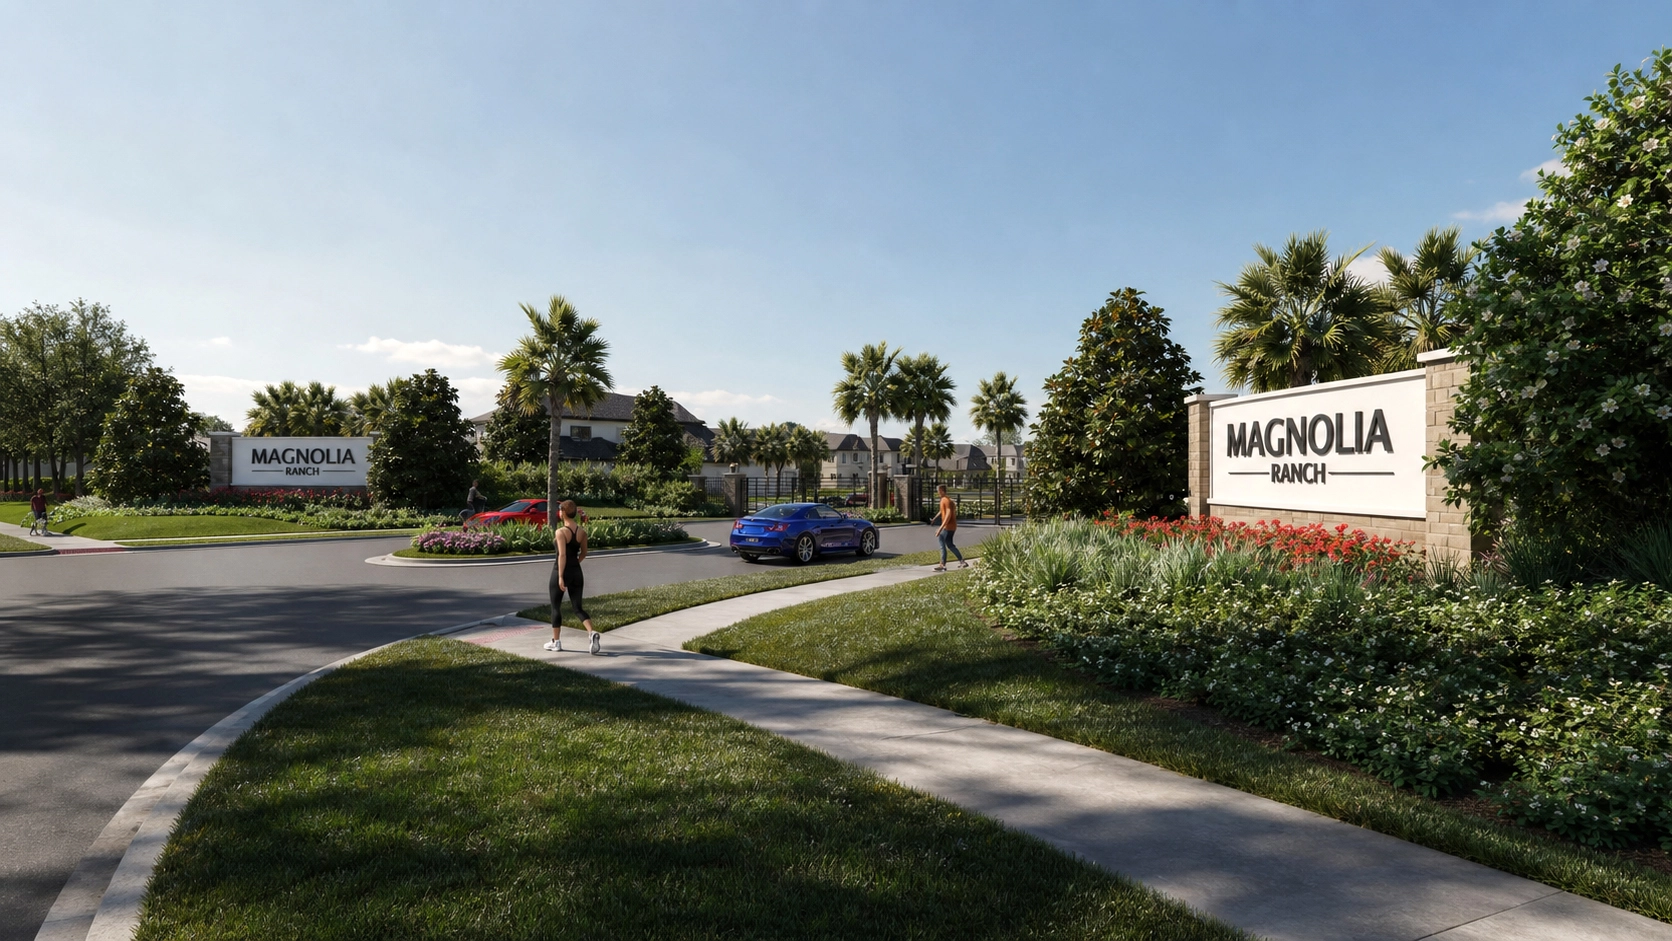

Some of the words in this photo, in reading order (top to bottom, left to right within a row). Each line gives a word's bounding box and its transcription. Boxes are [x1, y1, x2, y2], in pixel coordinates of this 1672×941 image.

[1227, 408, 1394, 457] MAGNOLIA
[251, 448, 356, 465] MAGNOLIA
[285, 467, 320, 476] RANCH
[1271, 463, 1326, 484] RANCH
